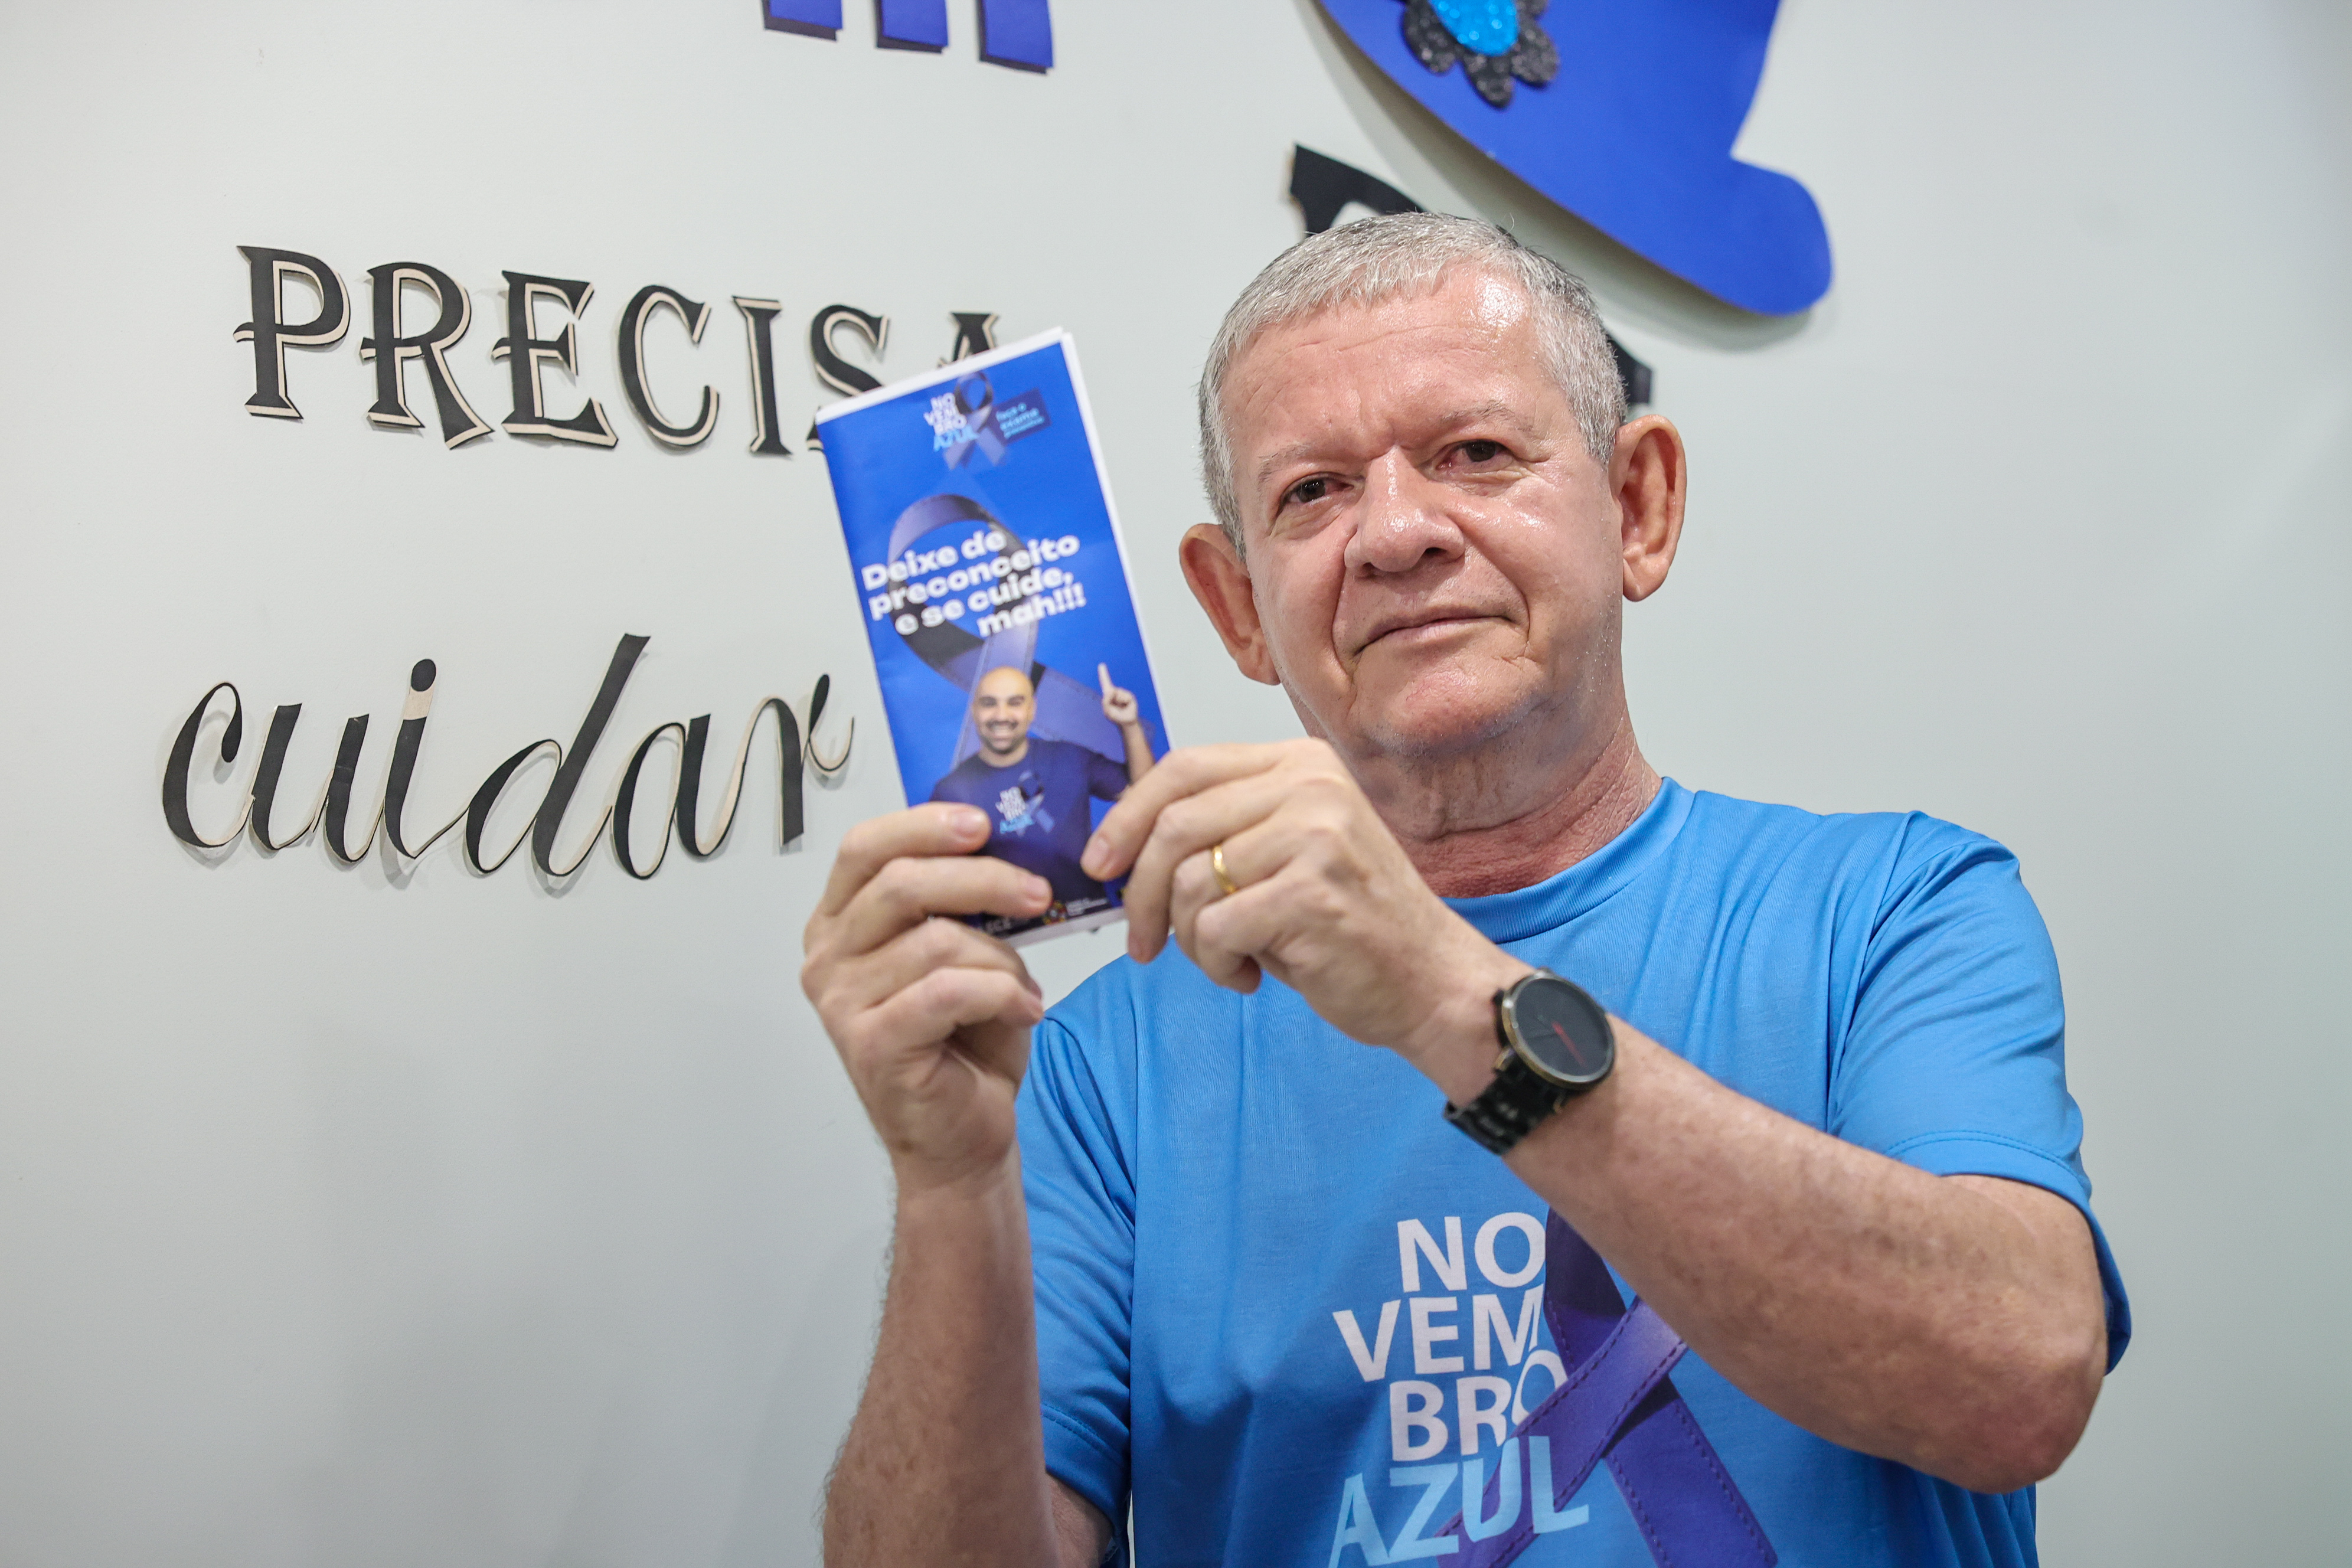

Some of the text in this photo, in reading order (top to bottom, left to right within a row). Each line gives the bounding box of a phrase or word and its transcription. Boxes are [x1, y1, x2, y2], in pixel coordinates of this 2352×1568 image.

[930, 393, 956, 409] NO
[933, 424, 979, 452] AZUL
[861, 529, 1007, 591] Deixe de
[868, 534, 1081, 622] preconceito
[894, 566, 1074, 636] e se cuide,
[976, 581, 1087, 638] mah!!!
[161, 632, 855, 881] cuidar
[1397, 1211, 1546, 1293] NO
[1332, 1283, 1544, 1383] VEM
[1327, 1435, 1590, 1568] AZUL
